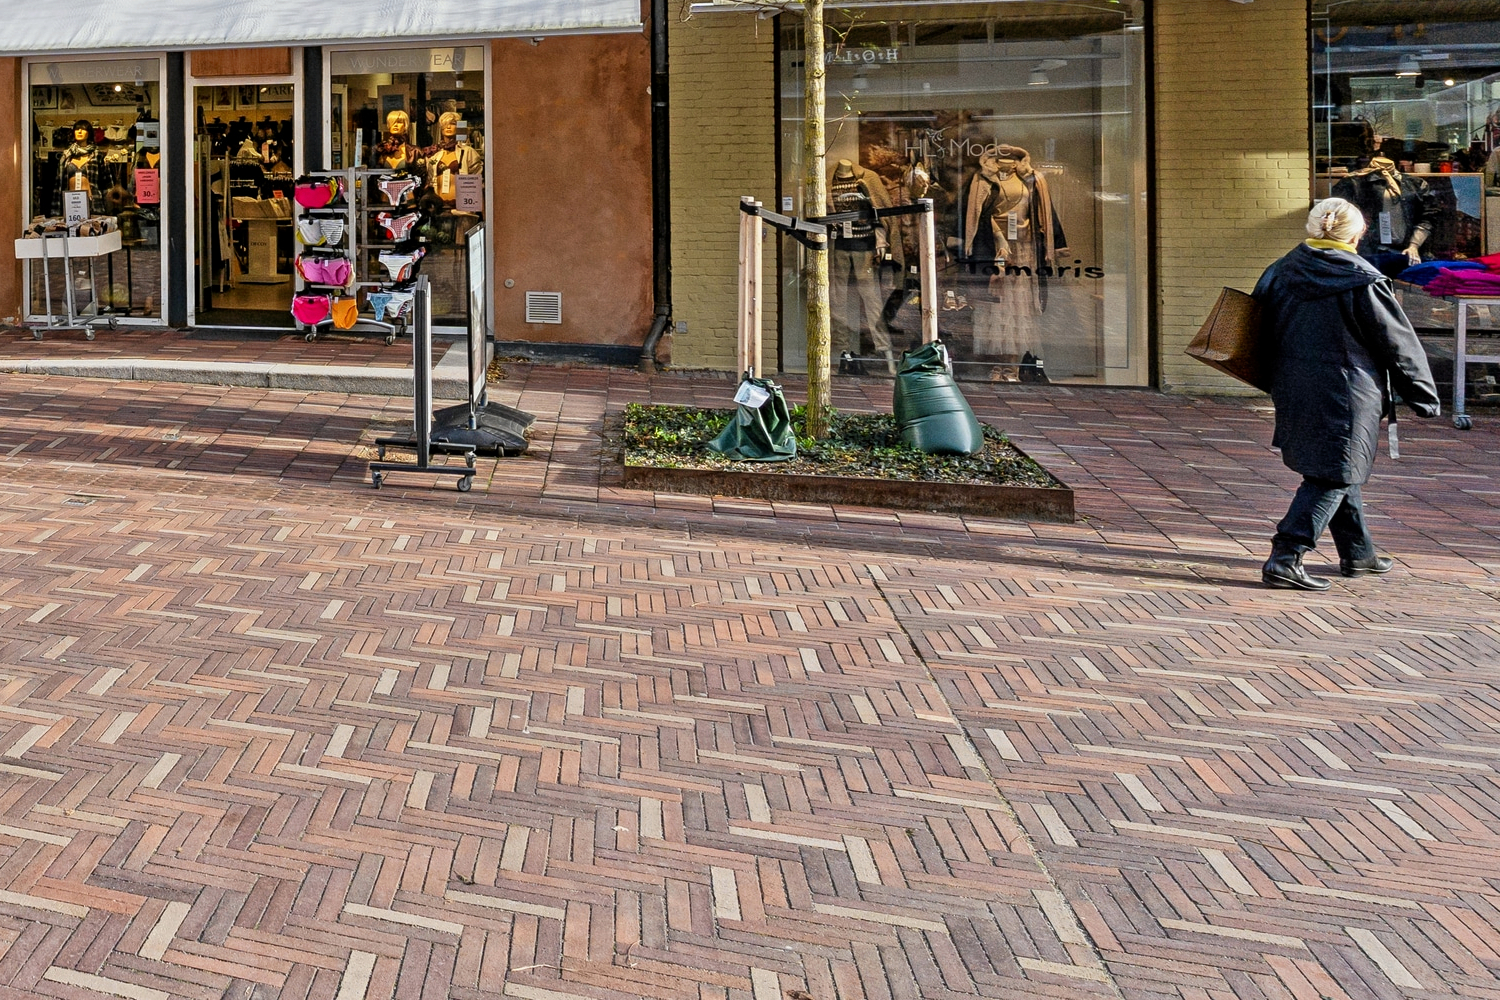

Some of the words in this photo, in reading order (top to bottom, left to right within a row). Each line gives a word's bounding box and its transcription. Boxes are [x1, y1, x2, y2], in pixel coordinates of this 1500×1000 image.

[949, 138, 1011, 157] Mode
[143, 190, 156, 198] 30.-
[953, 259, 1105, 279] Tamaris
